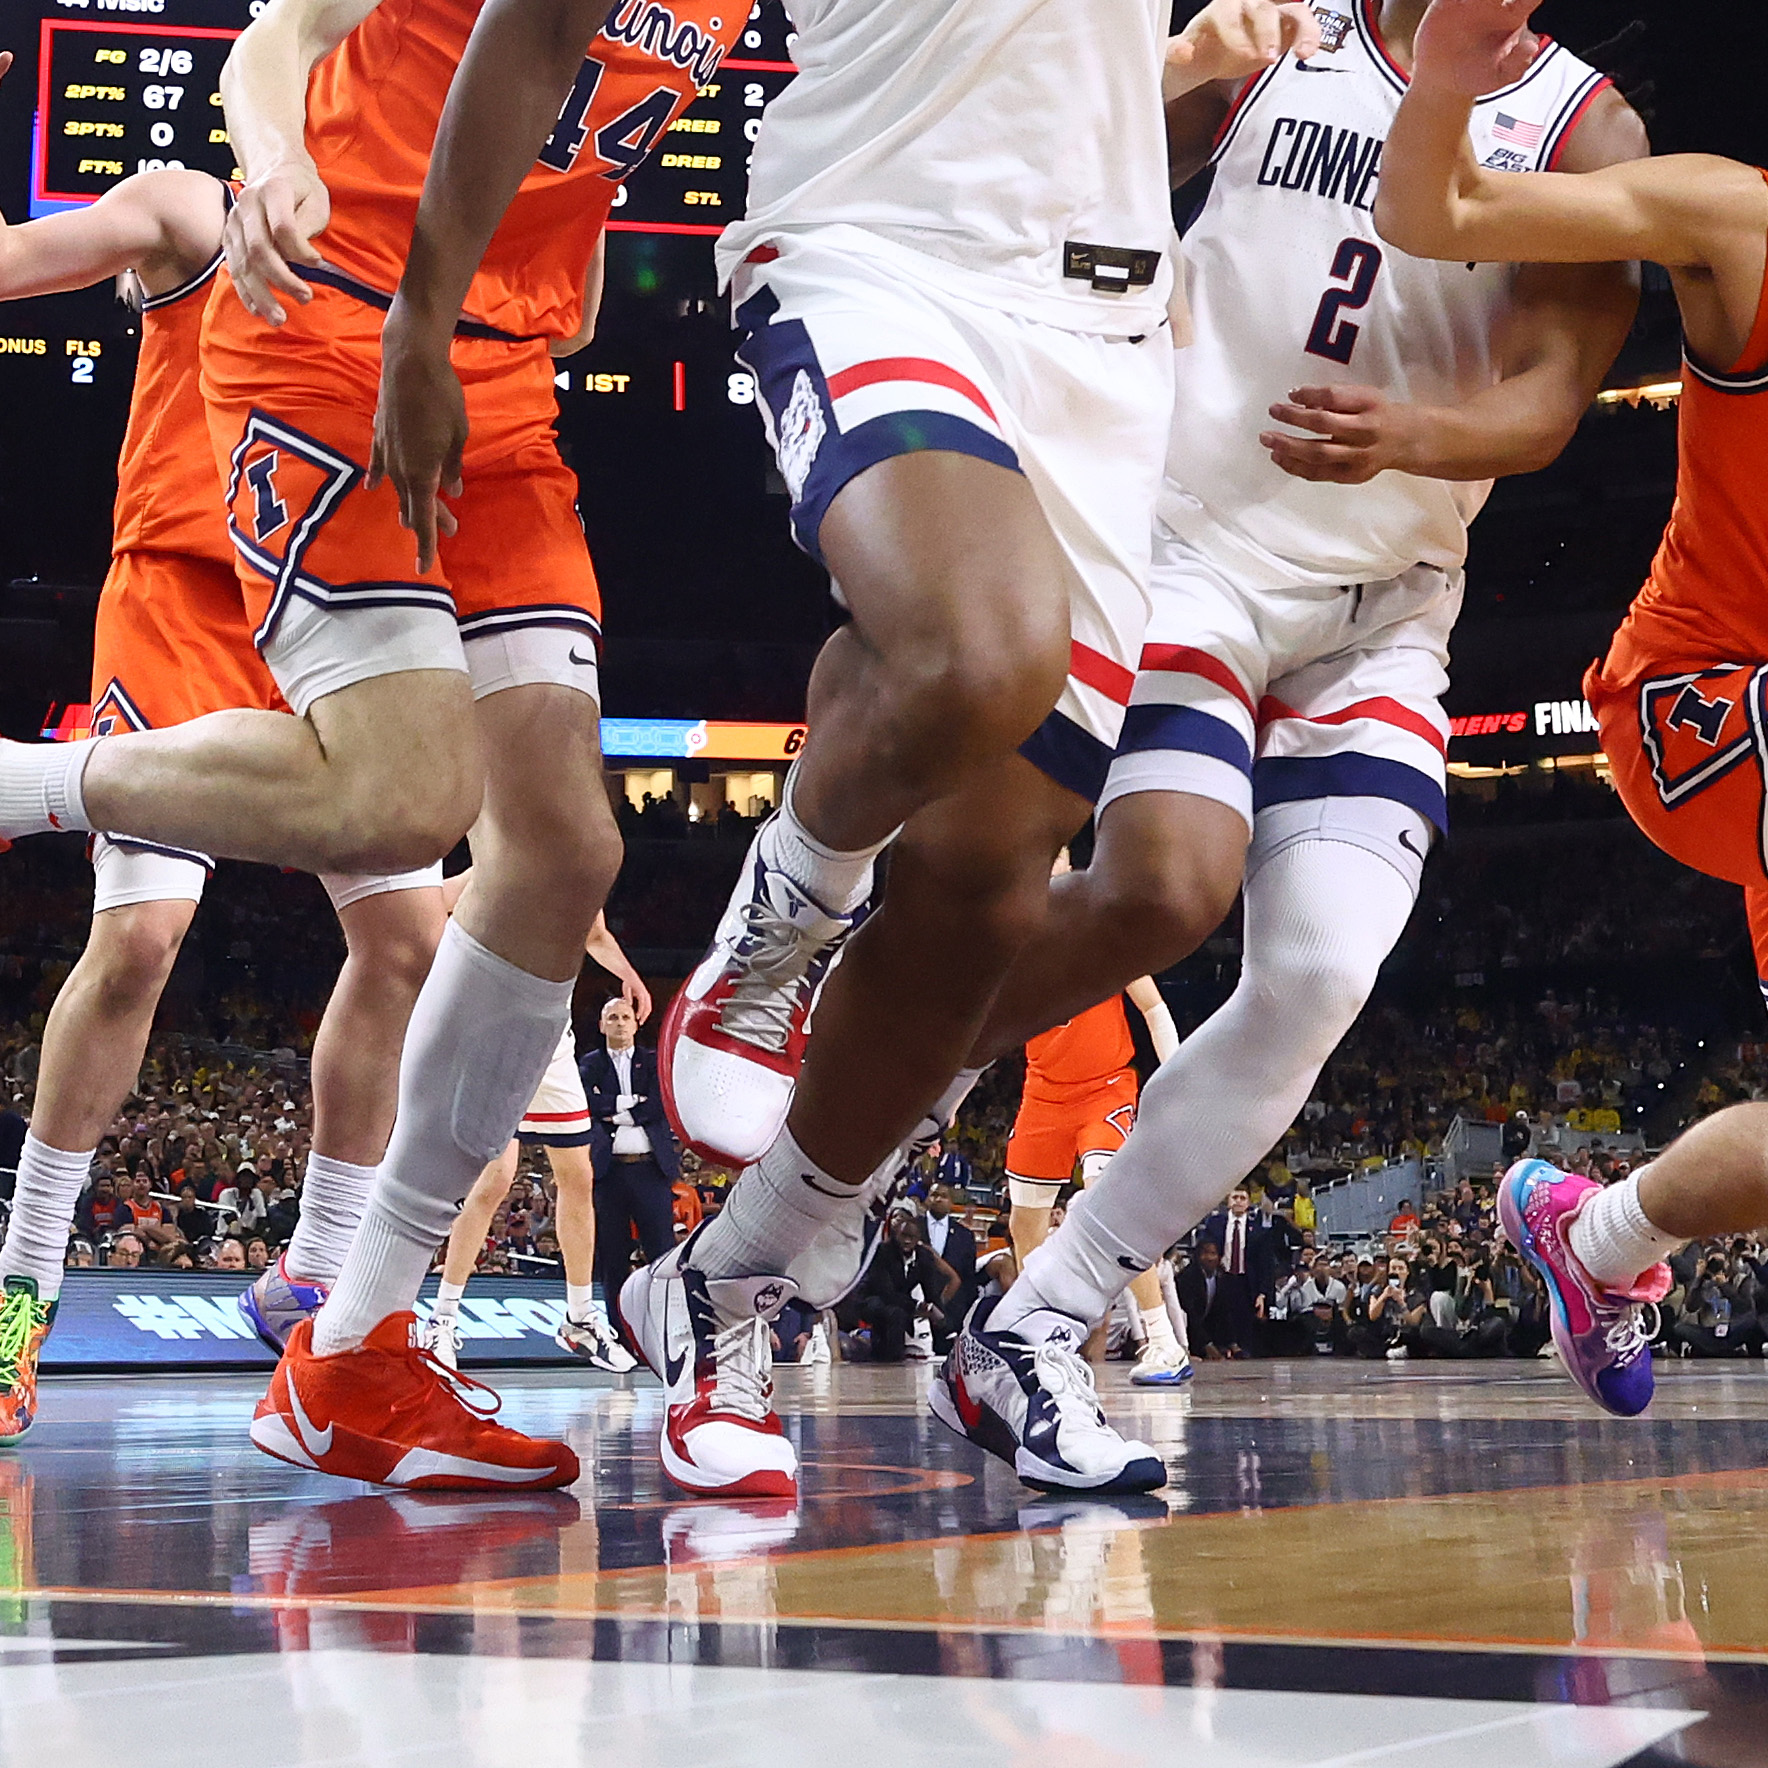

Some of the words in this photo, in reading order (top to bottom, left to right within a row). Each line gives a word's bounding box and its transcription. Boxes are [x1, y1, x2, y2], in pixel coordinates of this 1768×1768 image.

[95, 49, 127, 64] FG
[138, 48, 193, 77] 2/6
[64, 84, 126, 101] 2PT%
[142, 84, 185, 111] 67
[744, 83, 765, 107] 2
[63, 121, 124, 138] 3PT%
[150, 122, 175, 147] 0
[78, 160, 124, 175] FT%
[661, 154, 722, 170] DREB
[1492, 148, 1527, 163] BIG
[683, 191, 722, 206] STL
[1304, 237, 1382, 365] 2
[65, 339, 101, 356] FLS
[71, 358, 94, 384] 2
[727, 383, 755, 406] 8
[1450, 712, 1528, 736] MEN'S
[1535, 700, 1600, 736] FINA
